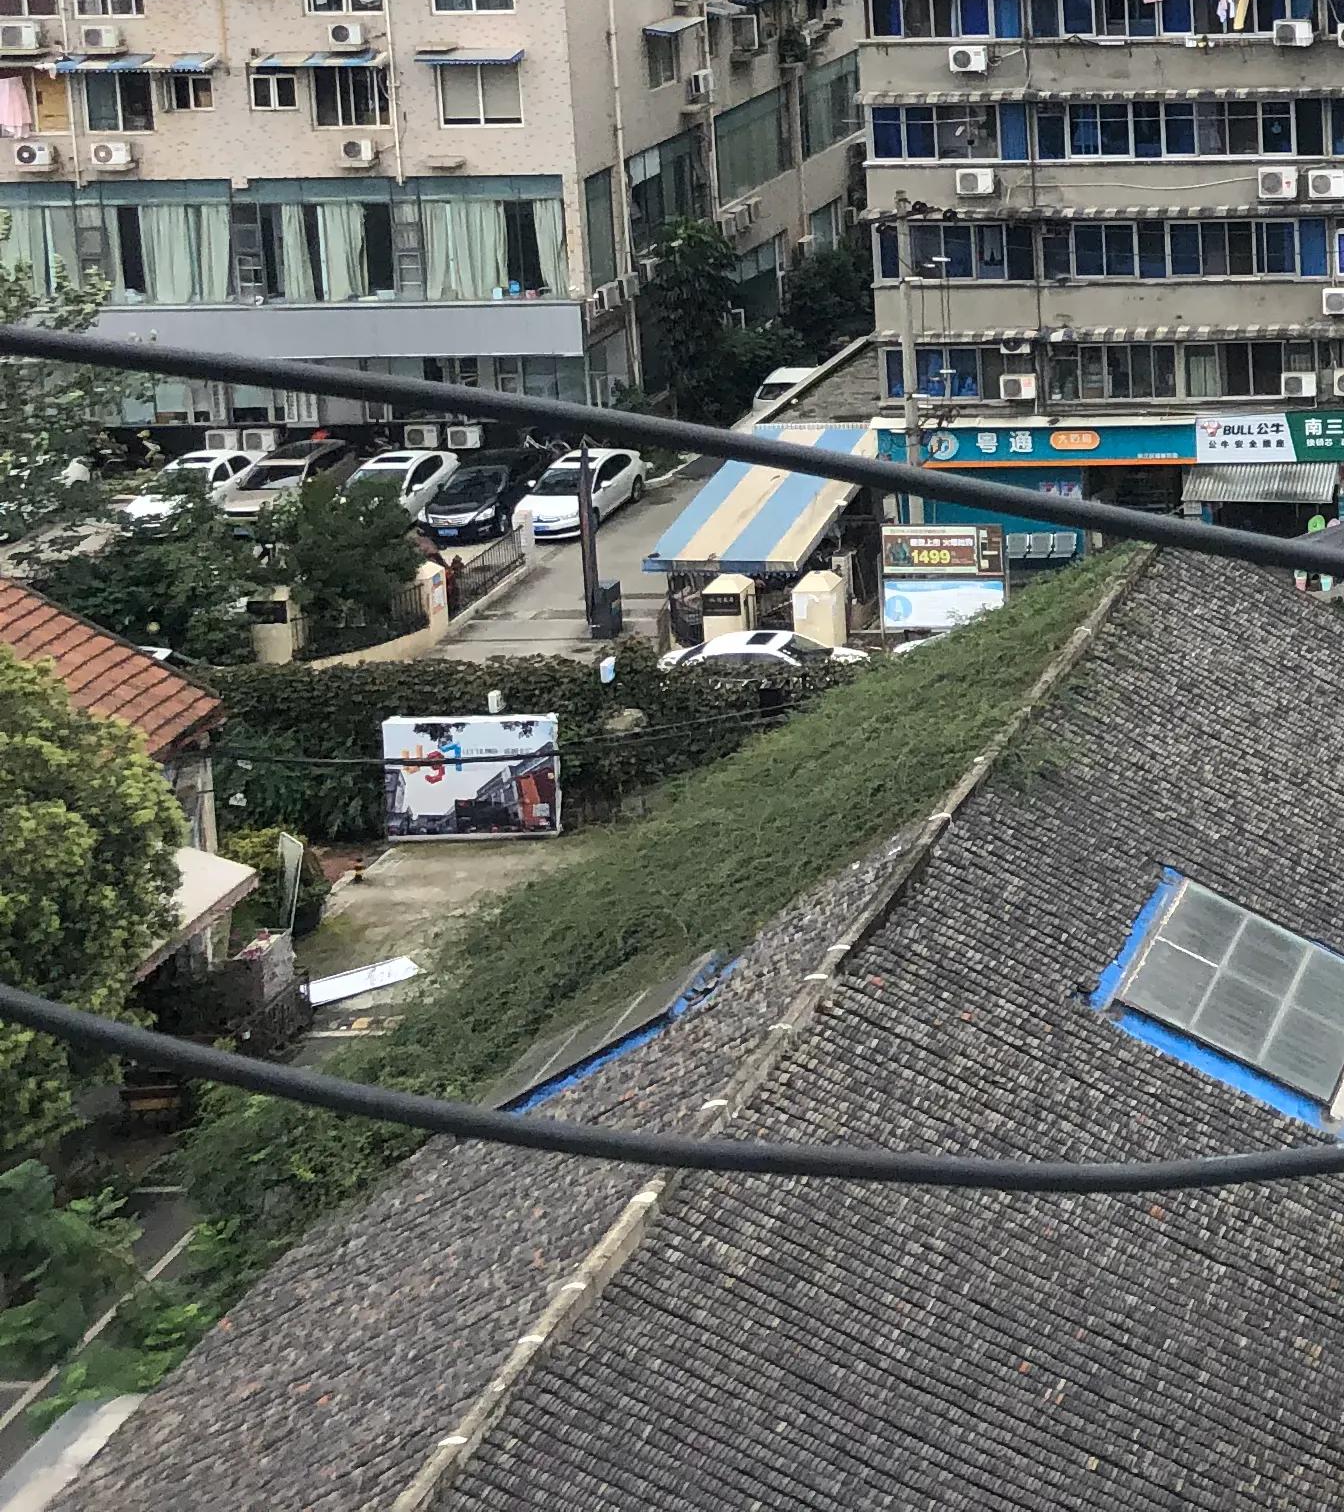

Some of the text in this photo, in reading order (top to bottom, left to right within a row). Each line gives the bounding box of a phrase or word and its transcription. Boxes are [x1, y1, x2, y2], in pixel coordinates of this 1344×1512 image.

[1223, 422, 1284, 436] BULL 公牛
[911, 549, 951, 564] 1499
